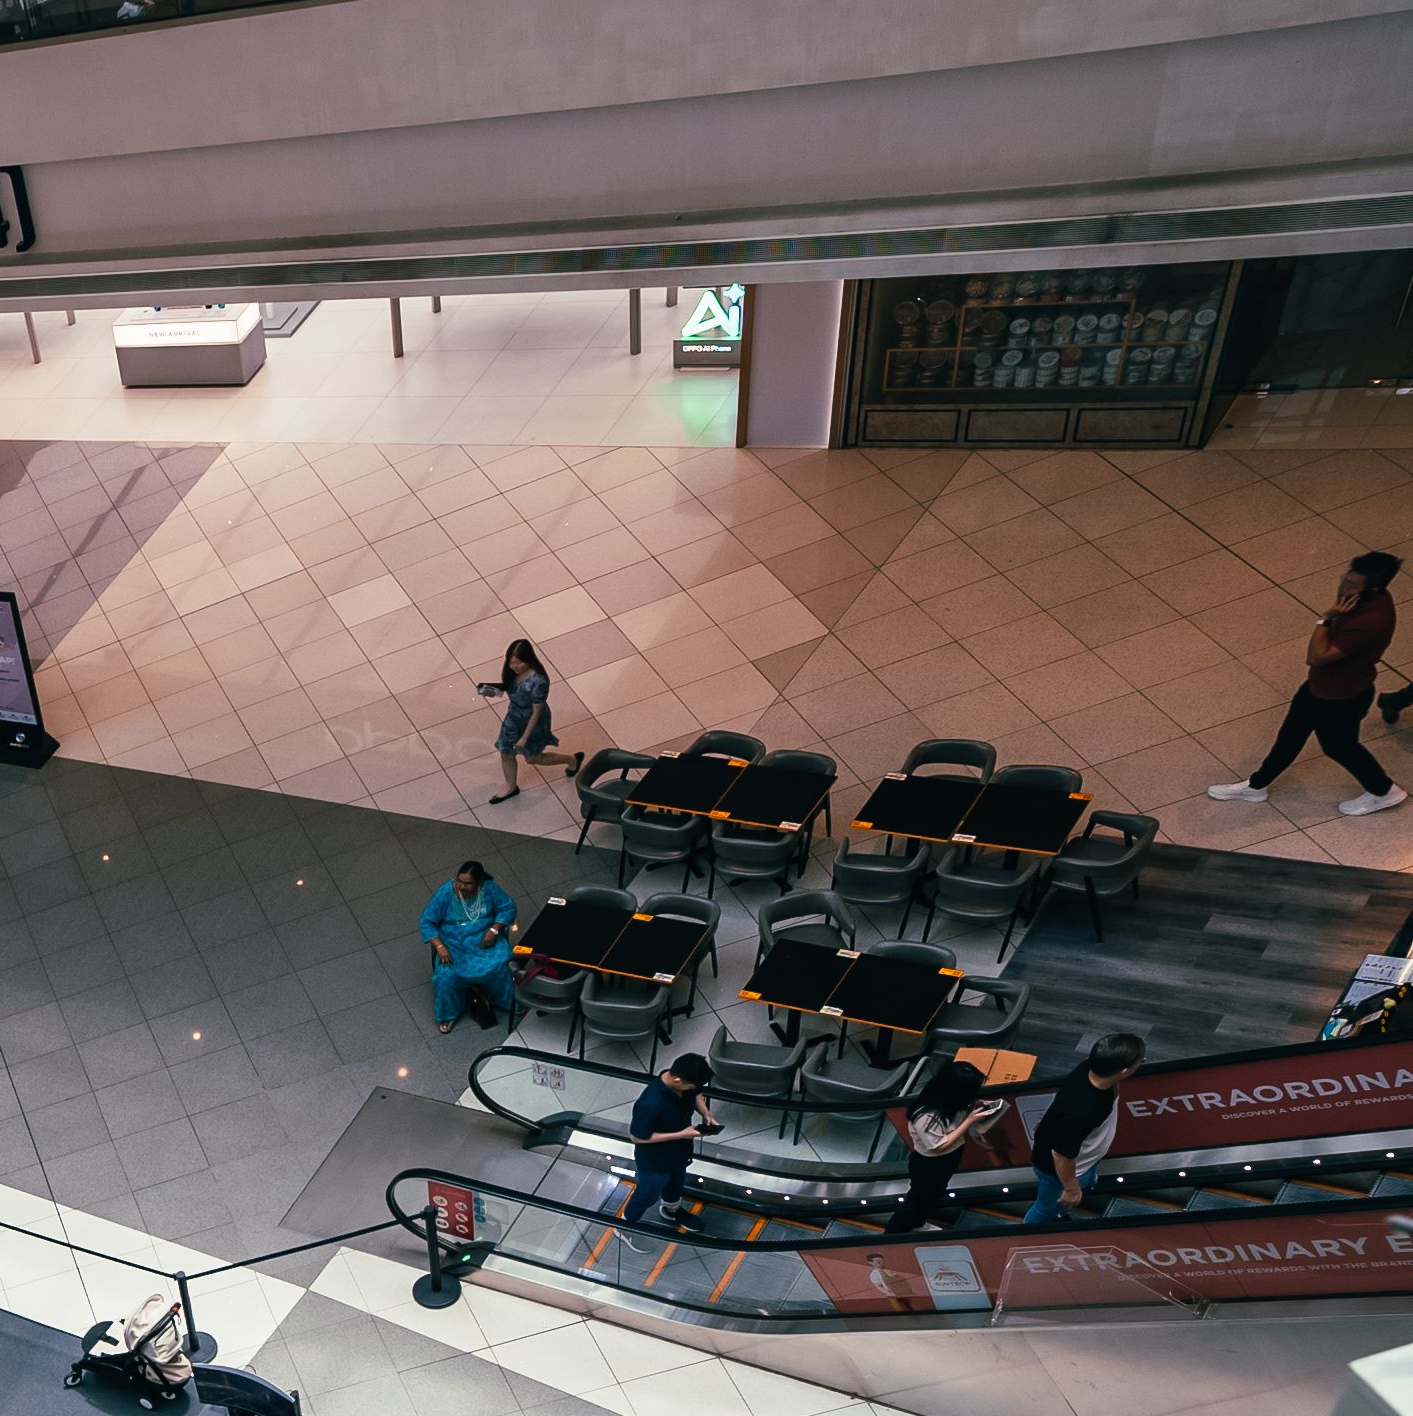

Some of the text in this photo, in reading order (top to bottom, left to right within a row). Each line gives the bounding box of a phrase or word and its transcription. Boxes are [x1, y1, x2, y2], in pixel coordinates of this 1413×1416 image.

[168, 329, 201, 338] ARRIVAL
[1221, 1106, 1277, 1121] DISCOVER
[1291, 1101, 1332, 1113] WORLD
[1354, 1093, 1413, 1107] REWARDS
[1023, 1235, 1369, 1275] EXTRAORDINARY
[1184, 1268, 1224, 1279] WORLD
[1247, 1264, 1305, 1275] REWARDS
[1308, 1262, 1340, 1273] WITH
[1342, 1260, 1369, 1270] THE
